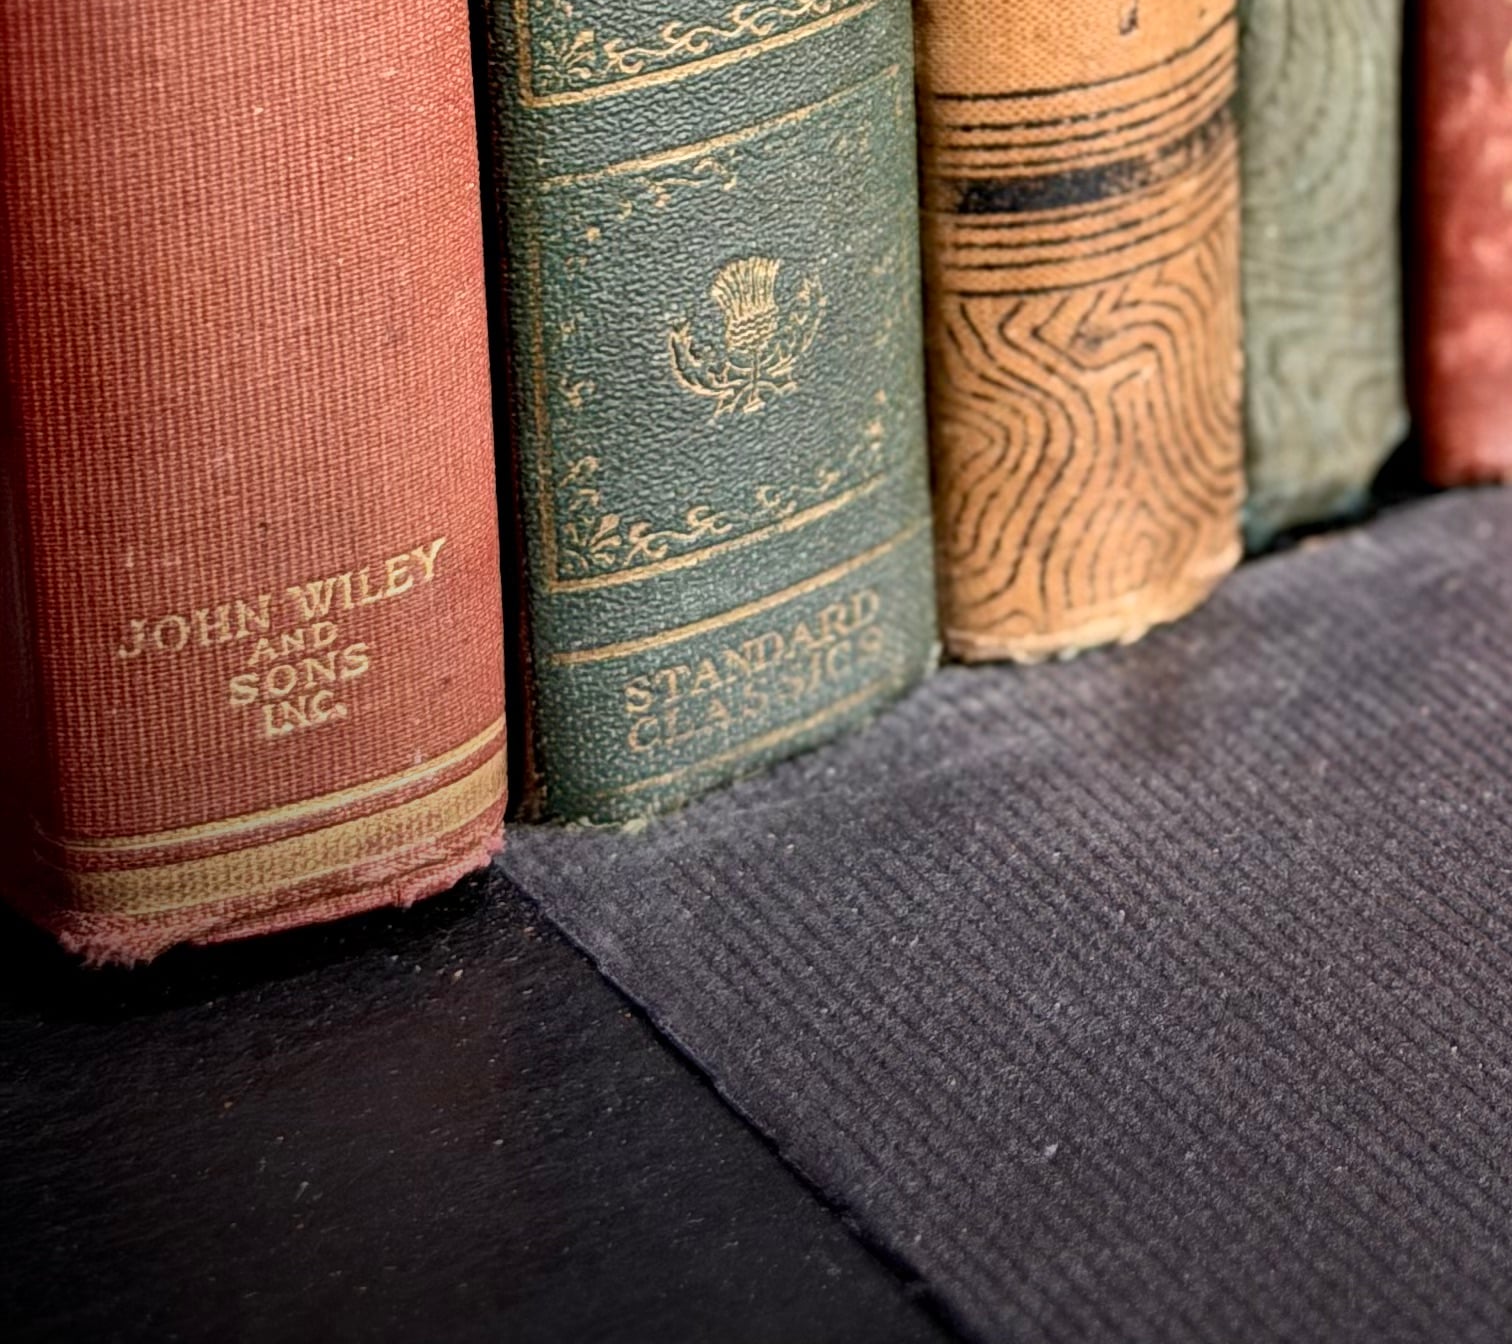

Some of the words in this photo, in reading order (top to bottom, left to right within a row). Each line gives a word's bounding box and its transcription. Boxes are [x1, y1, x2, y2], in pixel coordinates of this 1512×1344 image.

[118, 592, 271, 660] JOHN
[287, 537, 446, 622] WILEY
[247, 621, 338, 667] AND
[623, 588, 880, 714] STANDARD
[229, 642, 370, 705] SONS
[627, 625, 884, 753] CLASSICS
